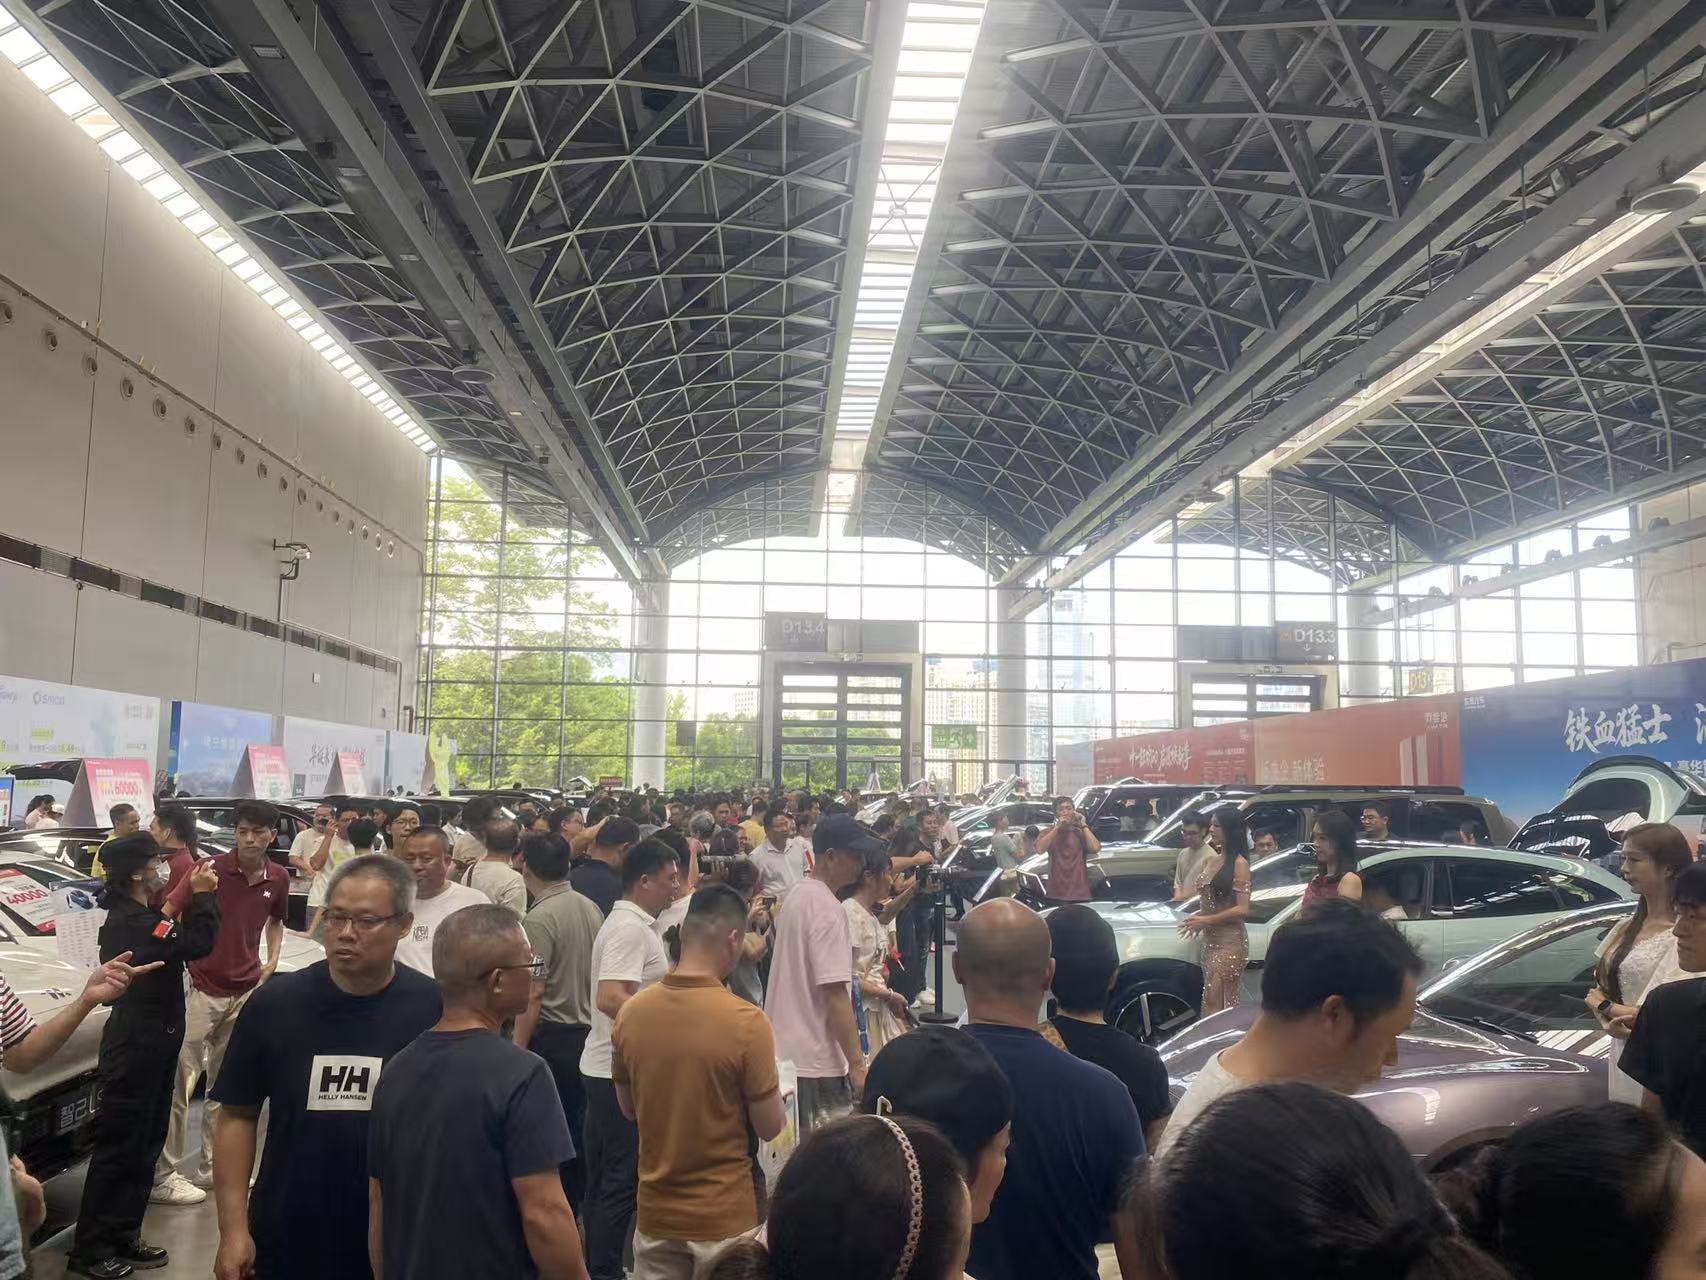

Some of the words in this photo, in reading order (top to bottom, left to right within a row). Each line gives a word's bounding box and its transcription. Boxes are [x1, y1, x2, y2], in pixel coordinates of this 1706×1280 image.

[783, 620, 825, 633] D13.4
[1295, 629, 1336, 643] D13.3
[1564, 703, 1673, 753] 铁血猛士
[7, 889, 49, 905] 40000
[319, 1066, 371, 1092] HH
